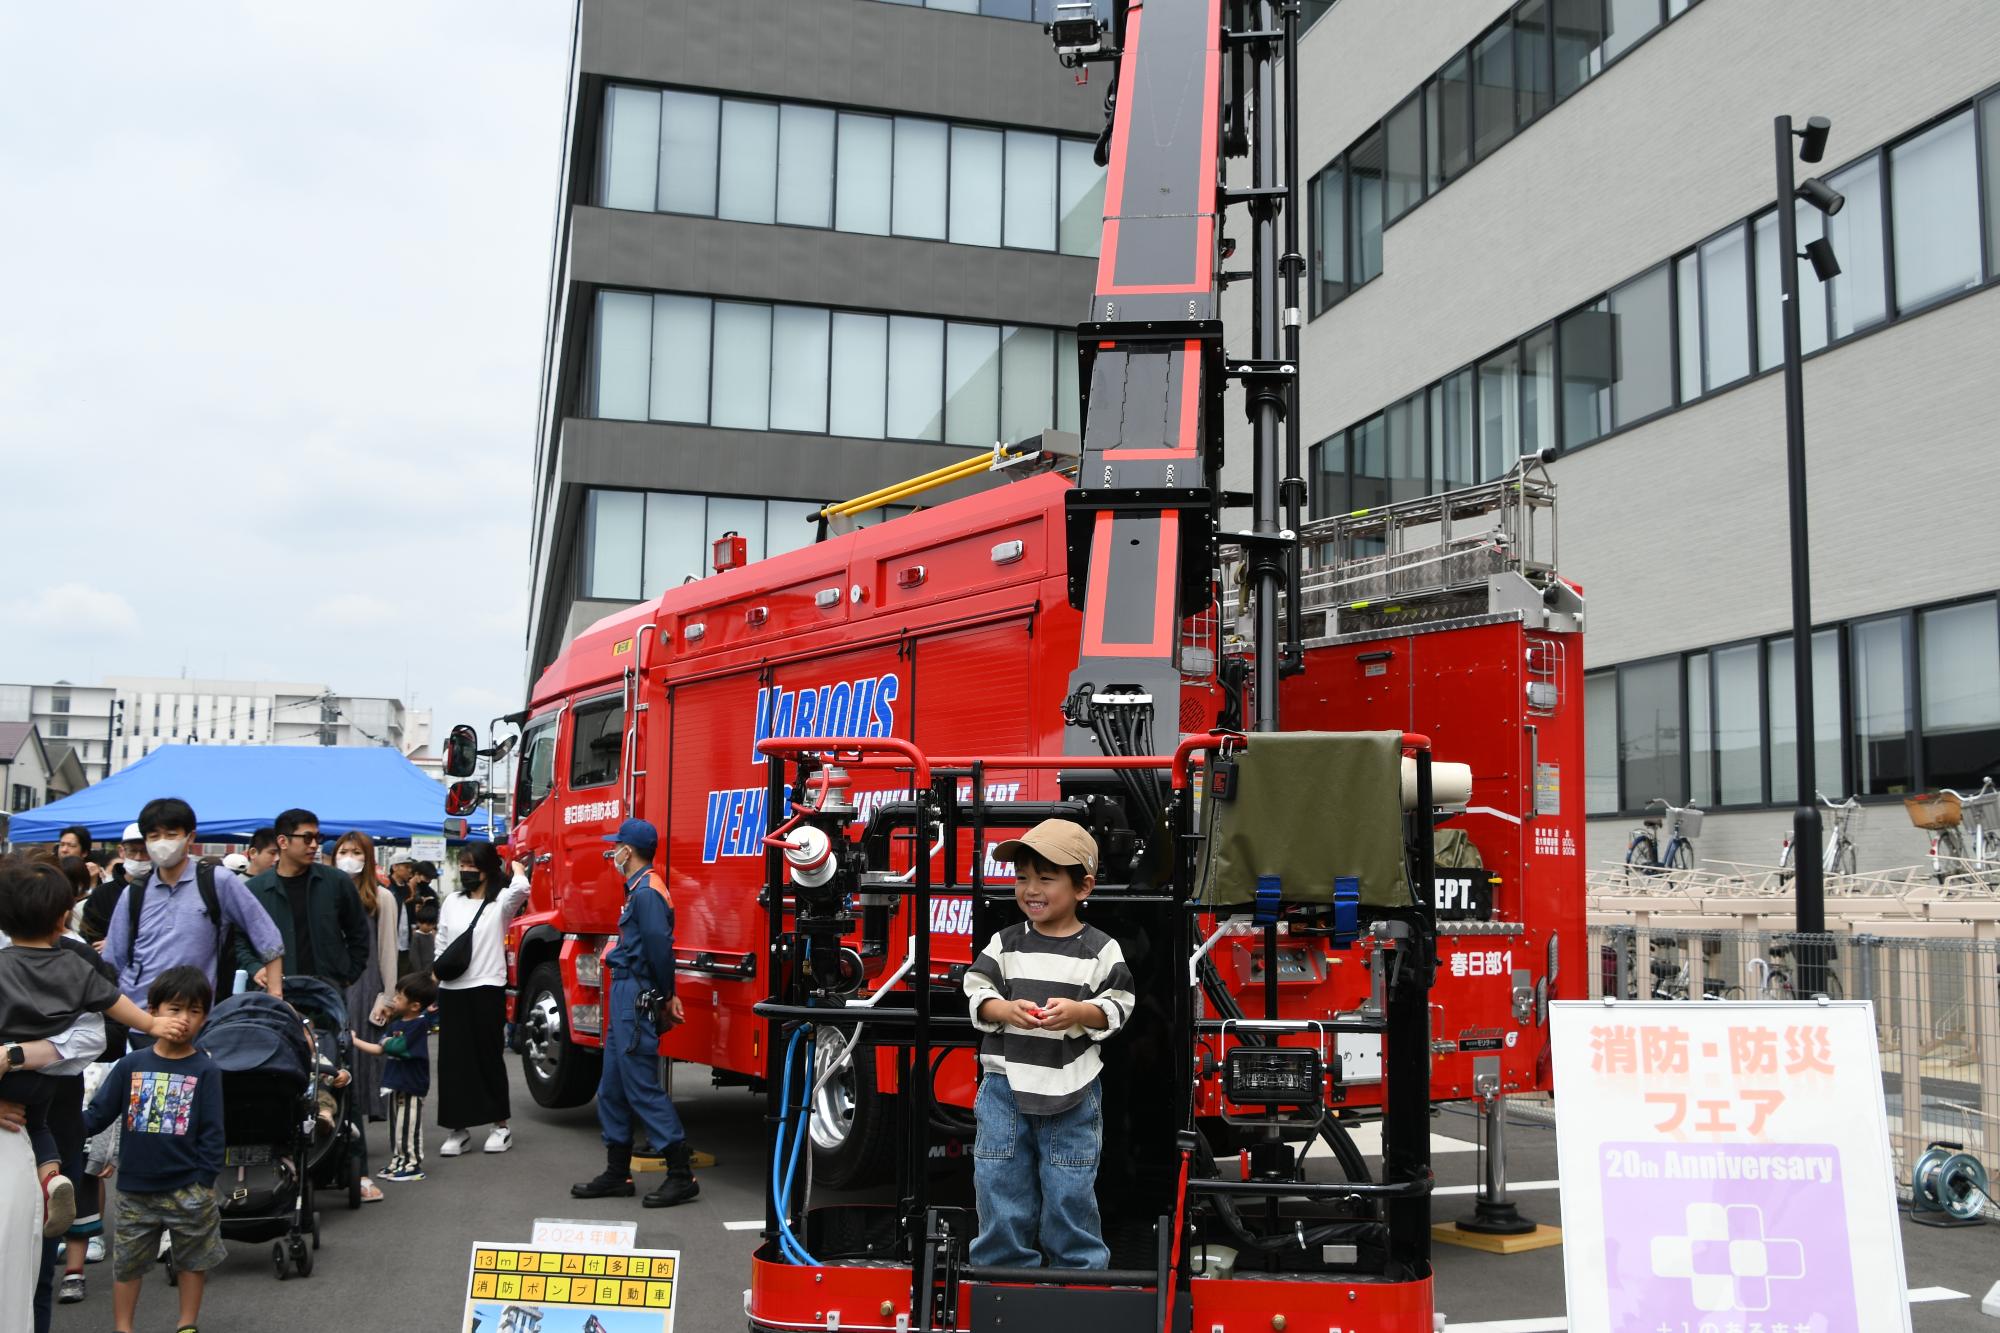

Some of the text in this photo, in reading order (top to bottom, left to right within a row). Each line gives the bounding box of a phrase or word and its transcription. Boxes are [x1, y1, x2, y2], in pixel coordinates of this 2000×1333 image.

[752, 673, 899, 764] VARIOUS
[984, 783, 1020, 802] EPT
[1434, 878, 1476, 909] EPT.
[929, 898, 973, 935] KASU
[1450, 950, 1512, 977] 春日部1
[1590, 1024, 1836, 1075] 消防・防災
[1644, 1089, 1786, 1136] フェア
[1606, 1149, 1834, 1184] 20th Anniversary
